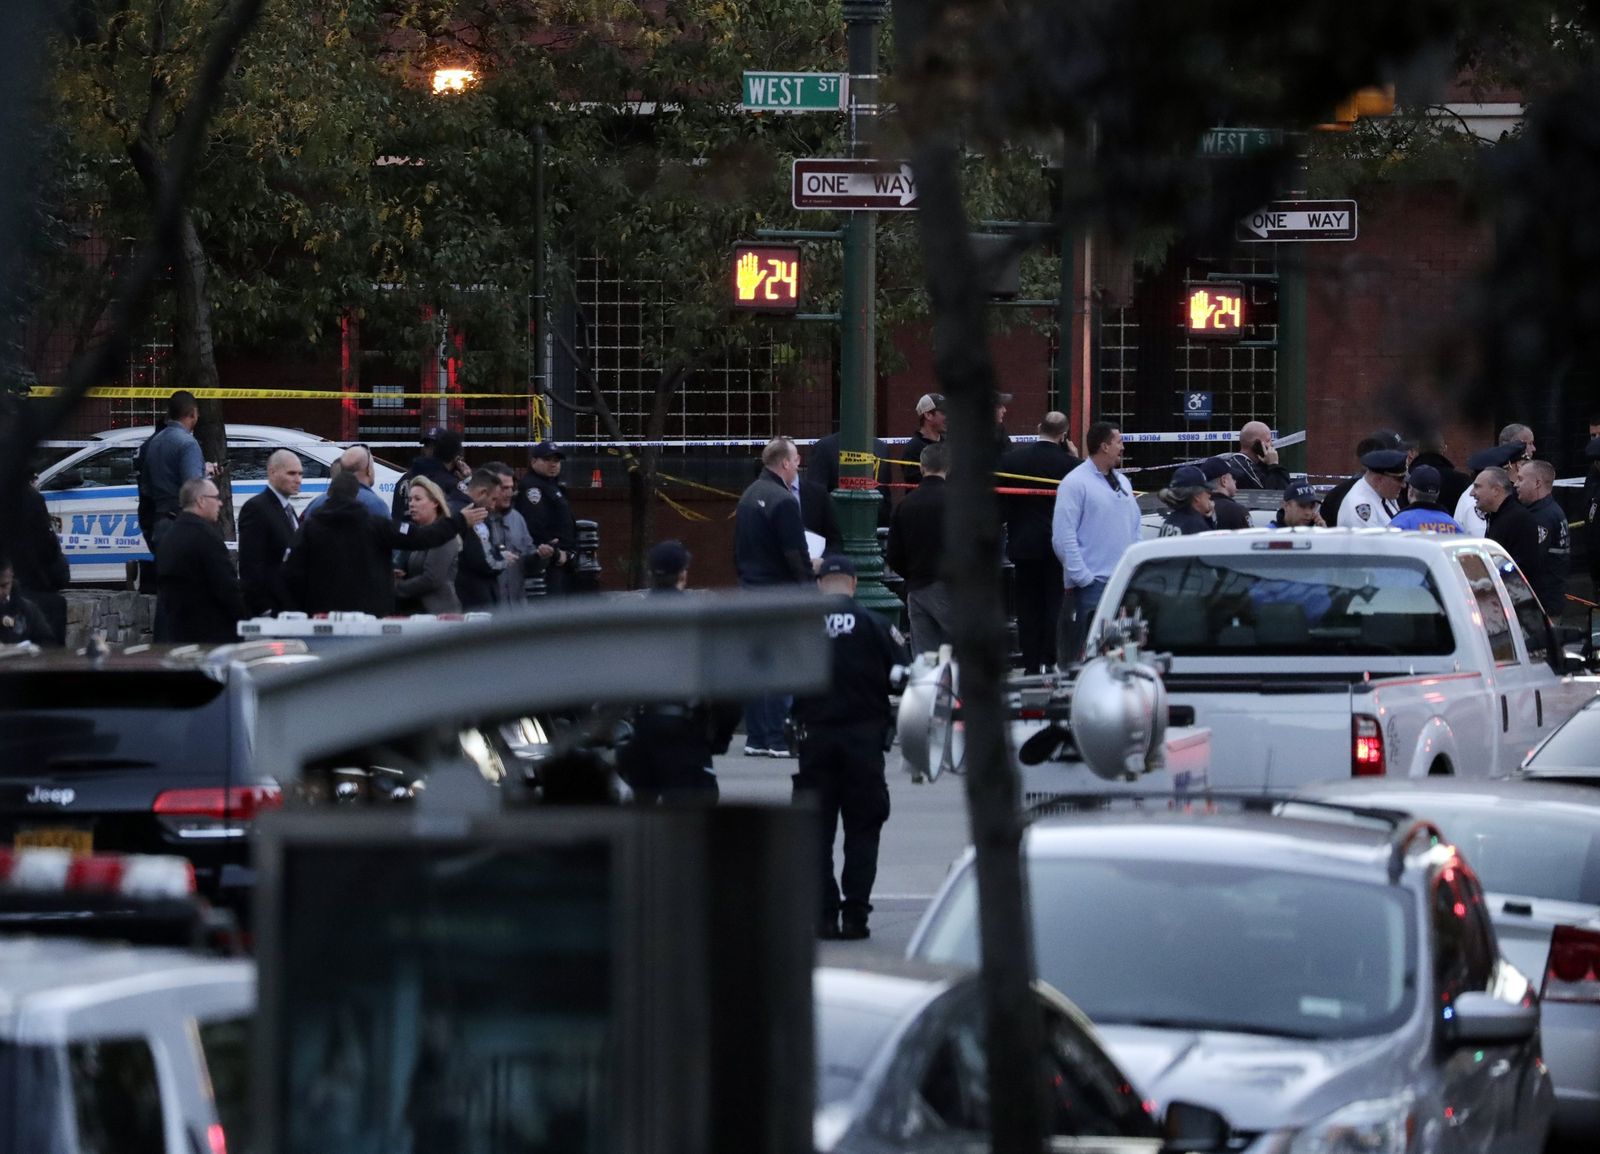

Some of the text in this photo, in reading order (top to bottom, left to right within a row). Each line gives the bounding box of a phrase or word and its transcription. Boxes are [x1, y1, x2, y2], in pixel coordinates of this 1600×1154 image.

[748, 77, 837, 105] WEST ST
[1202, 132, 1247, 154] WEST
[807, 175, 916, 194] ONE WAY
[1252, 213, 1345, 228] ONE WAY
[765, 259, 797, 299] 24
[1214, 296, 1240, 328] 24
[71, 513, 142, 537] NYP
[69, 536, 80, 545] DO
[93, 537, 110, 545] LINE
[115, 537, 141, 546] POLICE
[824, 613, 855, 632] YPD
[27, 784, 75, 806] Jeep
